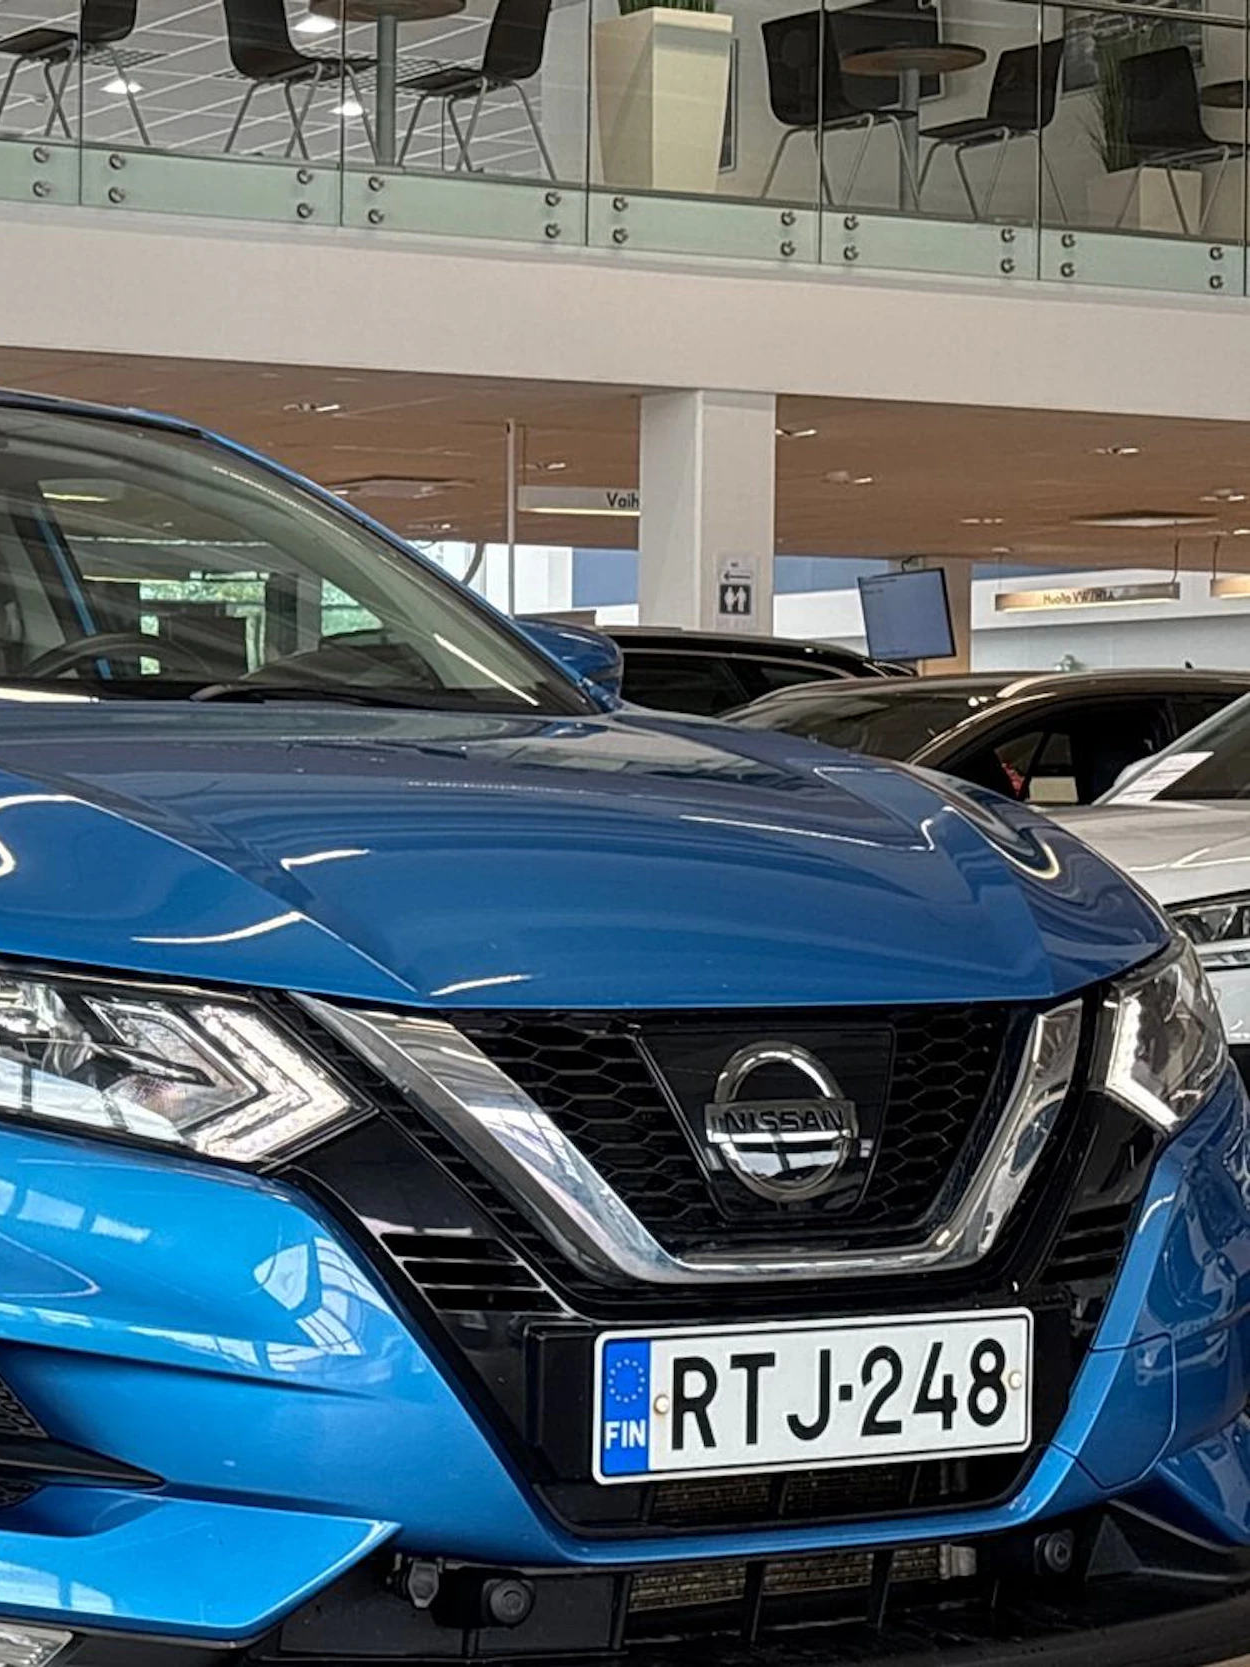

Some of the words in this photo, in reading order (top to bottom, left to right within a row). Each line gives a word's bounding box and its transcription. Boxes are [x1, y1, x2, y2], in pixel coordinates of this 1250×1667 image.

[724, 1107, 844, 1131] NISSAN
[671, 1338, 1008, 1450] RTJ-248
[605, 1419, 646, 1449] FIN
